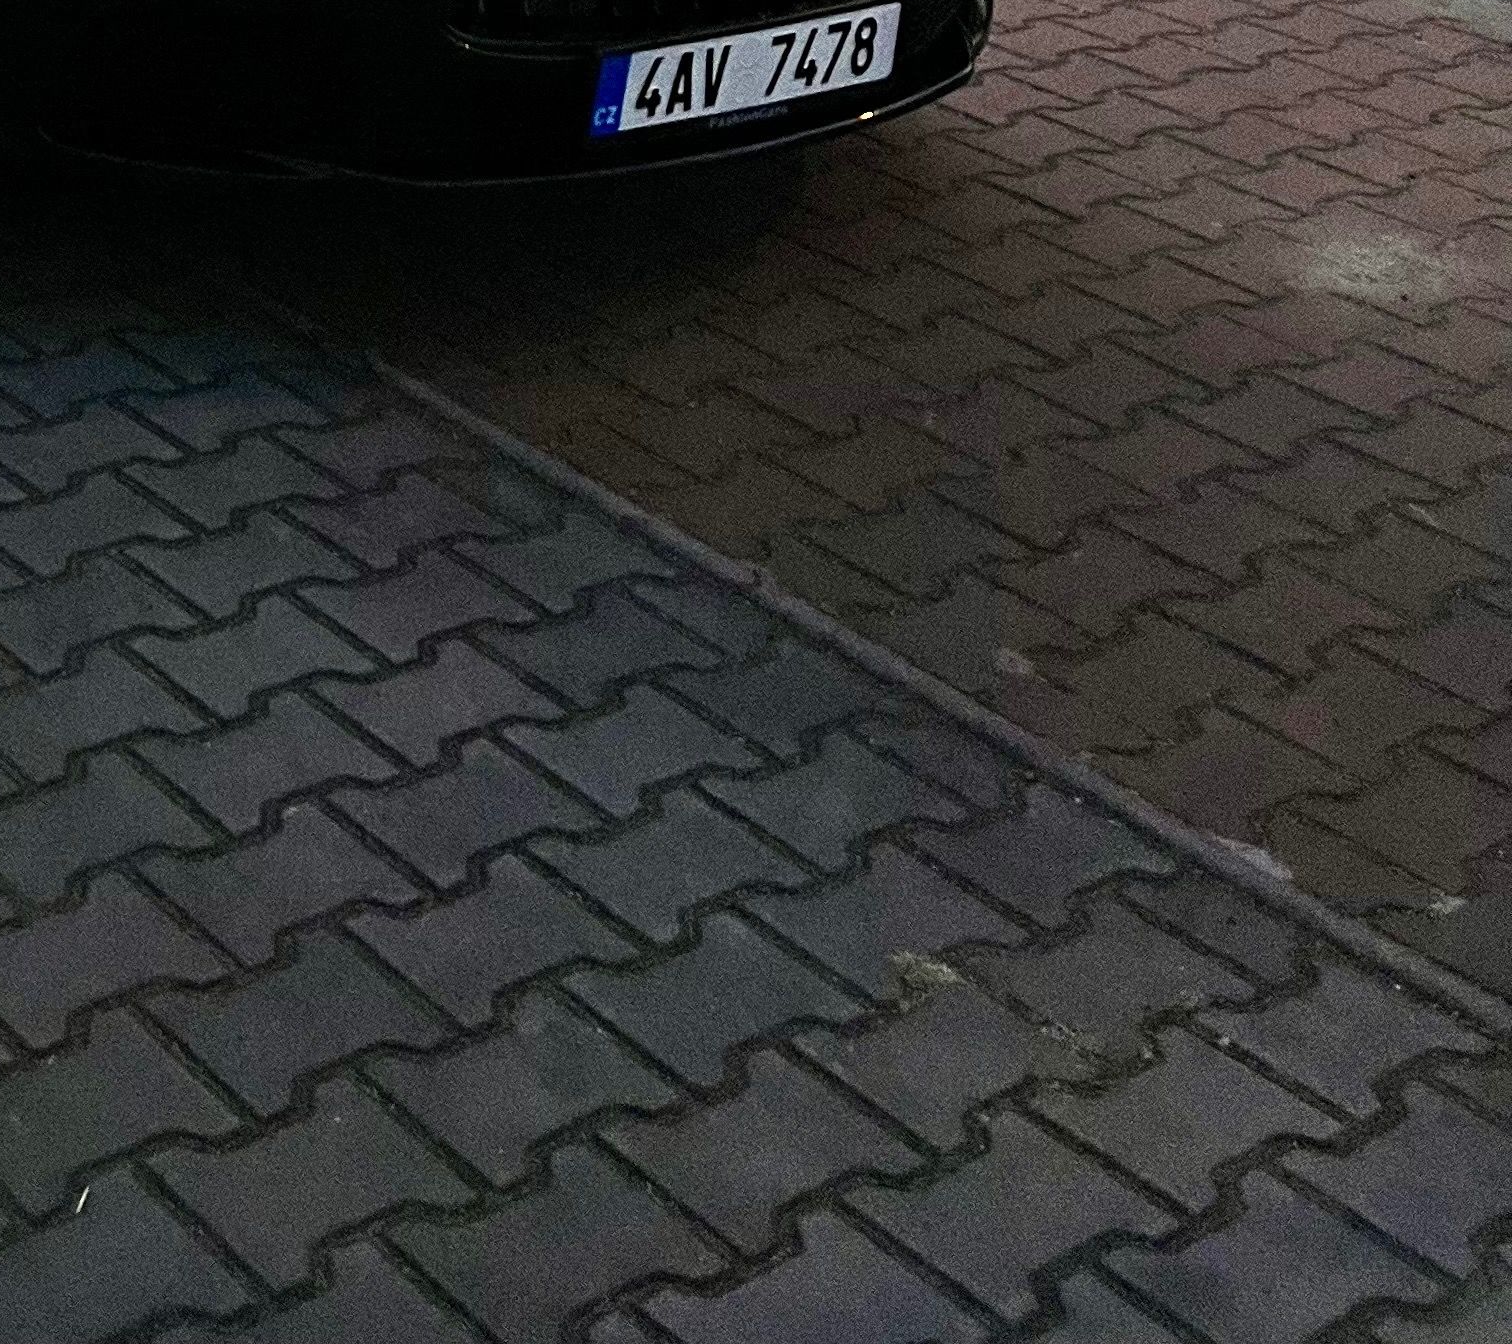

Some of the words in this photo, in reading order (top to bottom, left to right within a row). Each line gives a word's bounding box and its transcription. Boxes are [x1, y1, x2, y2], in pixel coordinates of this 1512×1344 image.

[635, 45, 732, 117] 4AV
[765, 17, 878, 97] 7478
[593, 105, 619, 127] CZ
